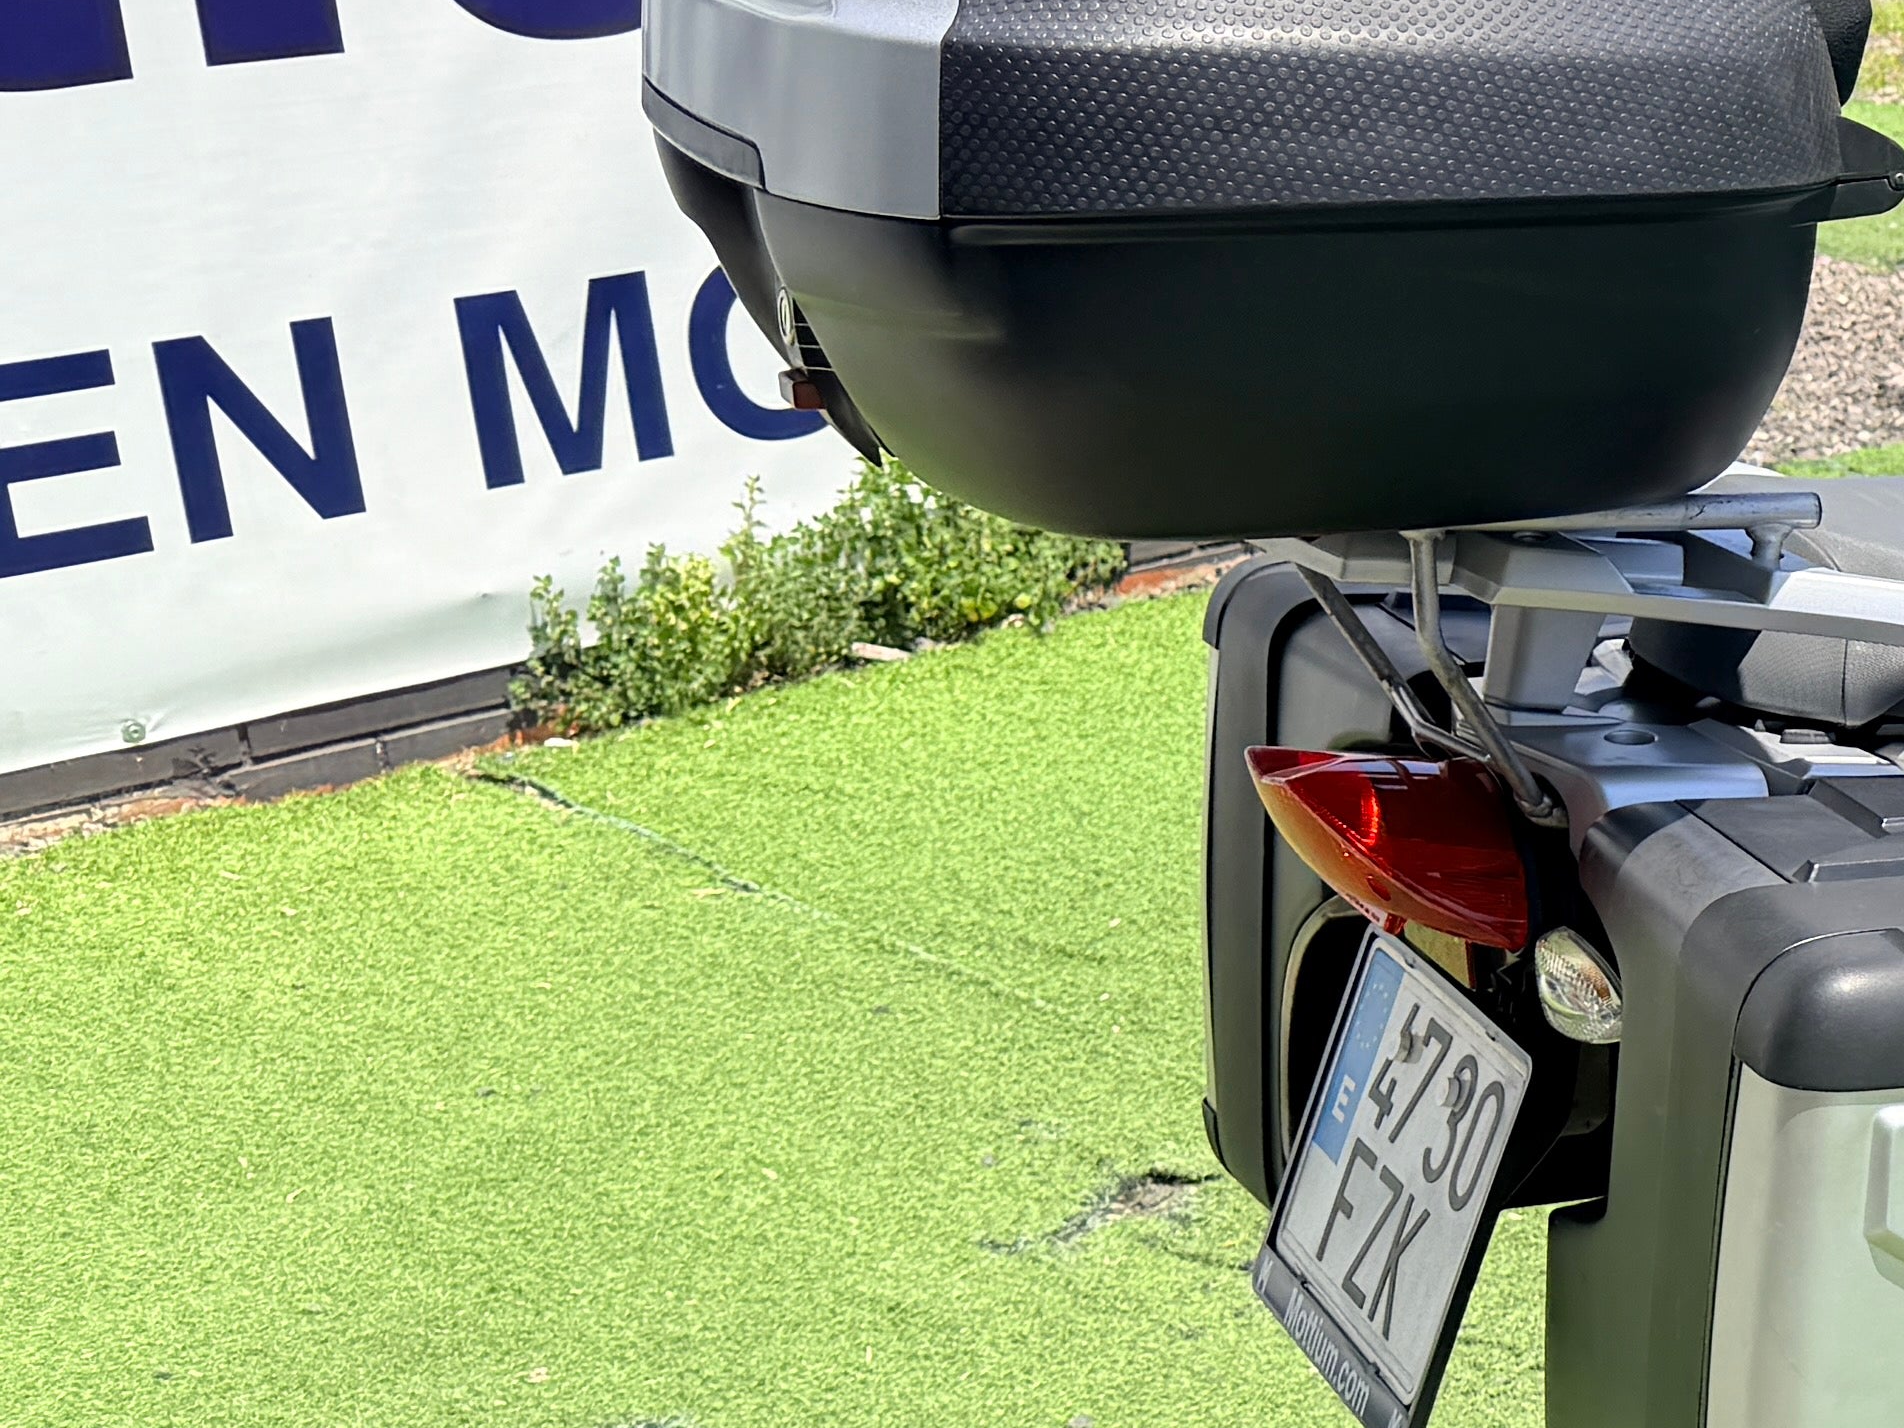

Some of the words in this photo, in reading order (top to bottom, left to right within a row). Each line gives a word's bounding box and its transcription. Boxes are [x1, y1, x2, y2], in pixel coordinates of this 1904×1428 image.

[1331, 1075, 1357, 1124] E
[1368, 1003, 1505, 1212] 4730
[1315, 1137, 1432, 1341] FZK
[1283, 1286, 1371, 1418] Mottium.com
